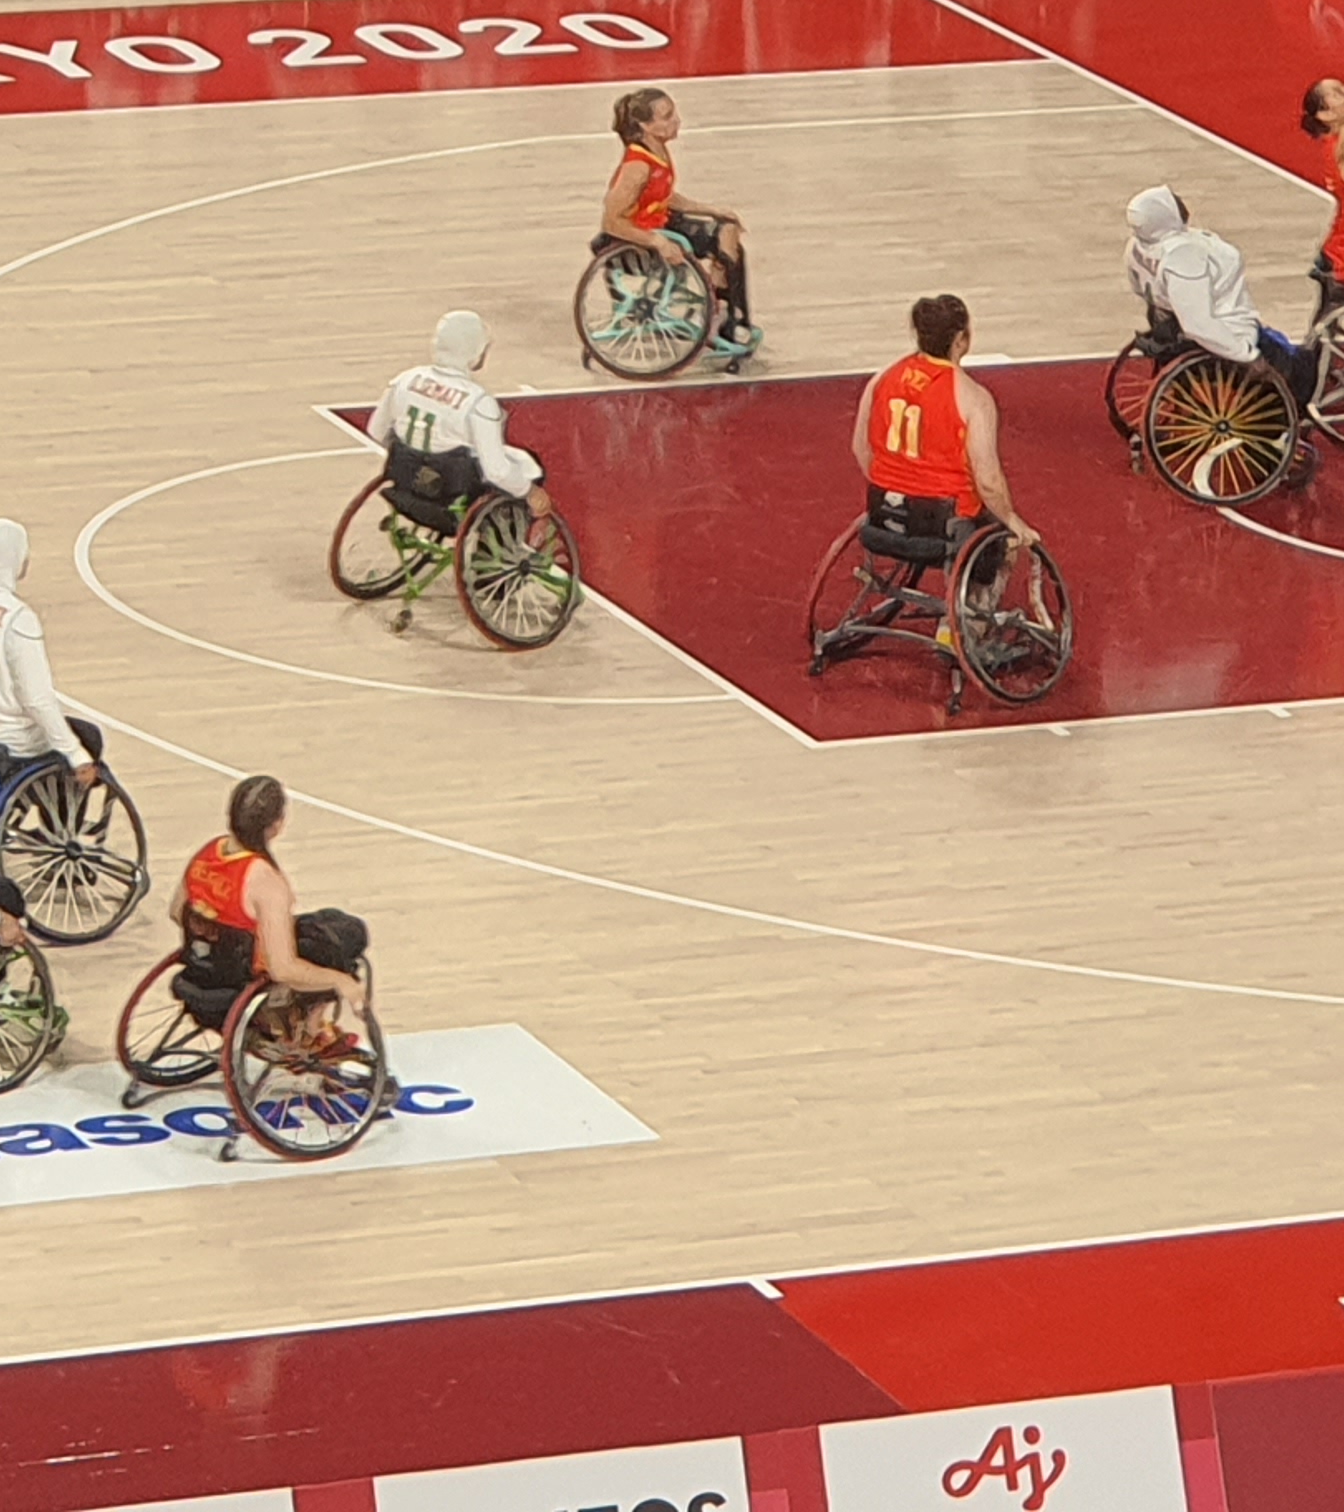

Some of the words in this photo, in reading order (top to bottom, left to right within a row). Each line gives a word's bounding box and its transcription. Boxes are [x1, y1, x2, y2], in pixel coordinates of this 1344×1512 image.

[246, 13, 671, 68] 2020
[405, 404, 437, 454] 11
[886, 397, 922, 459] 11
